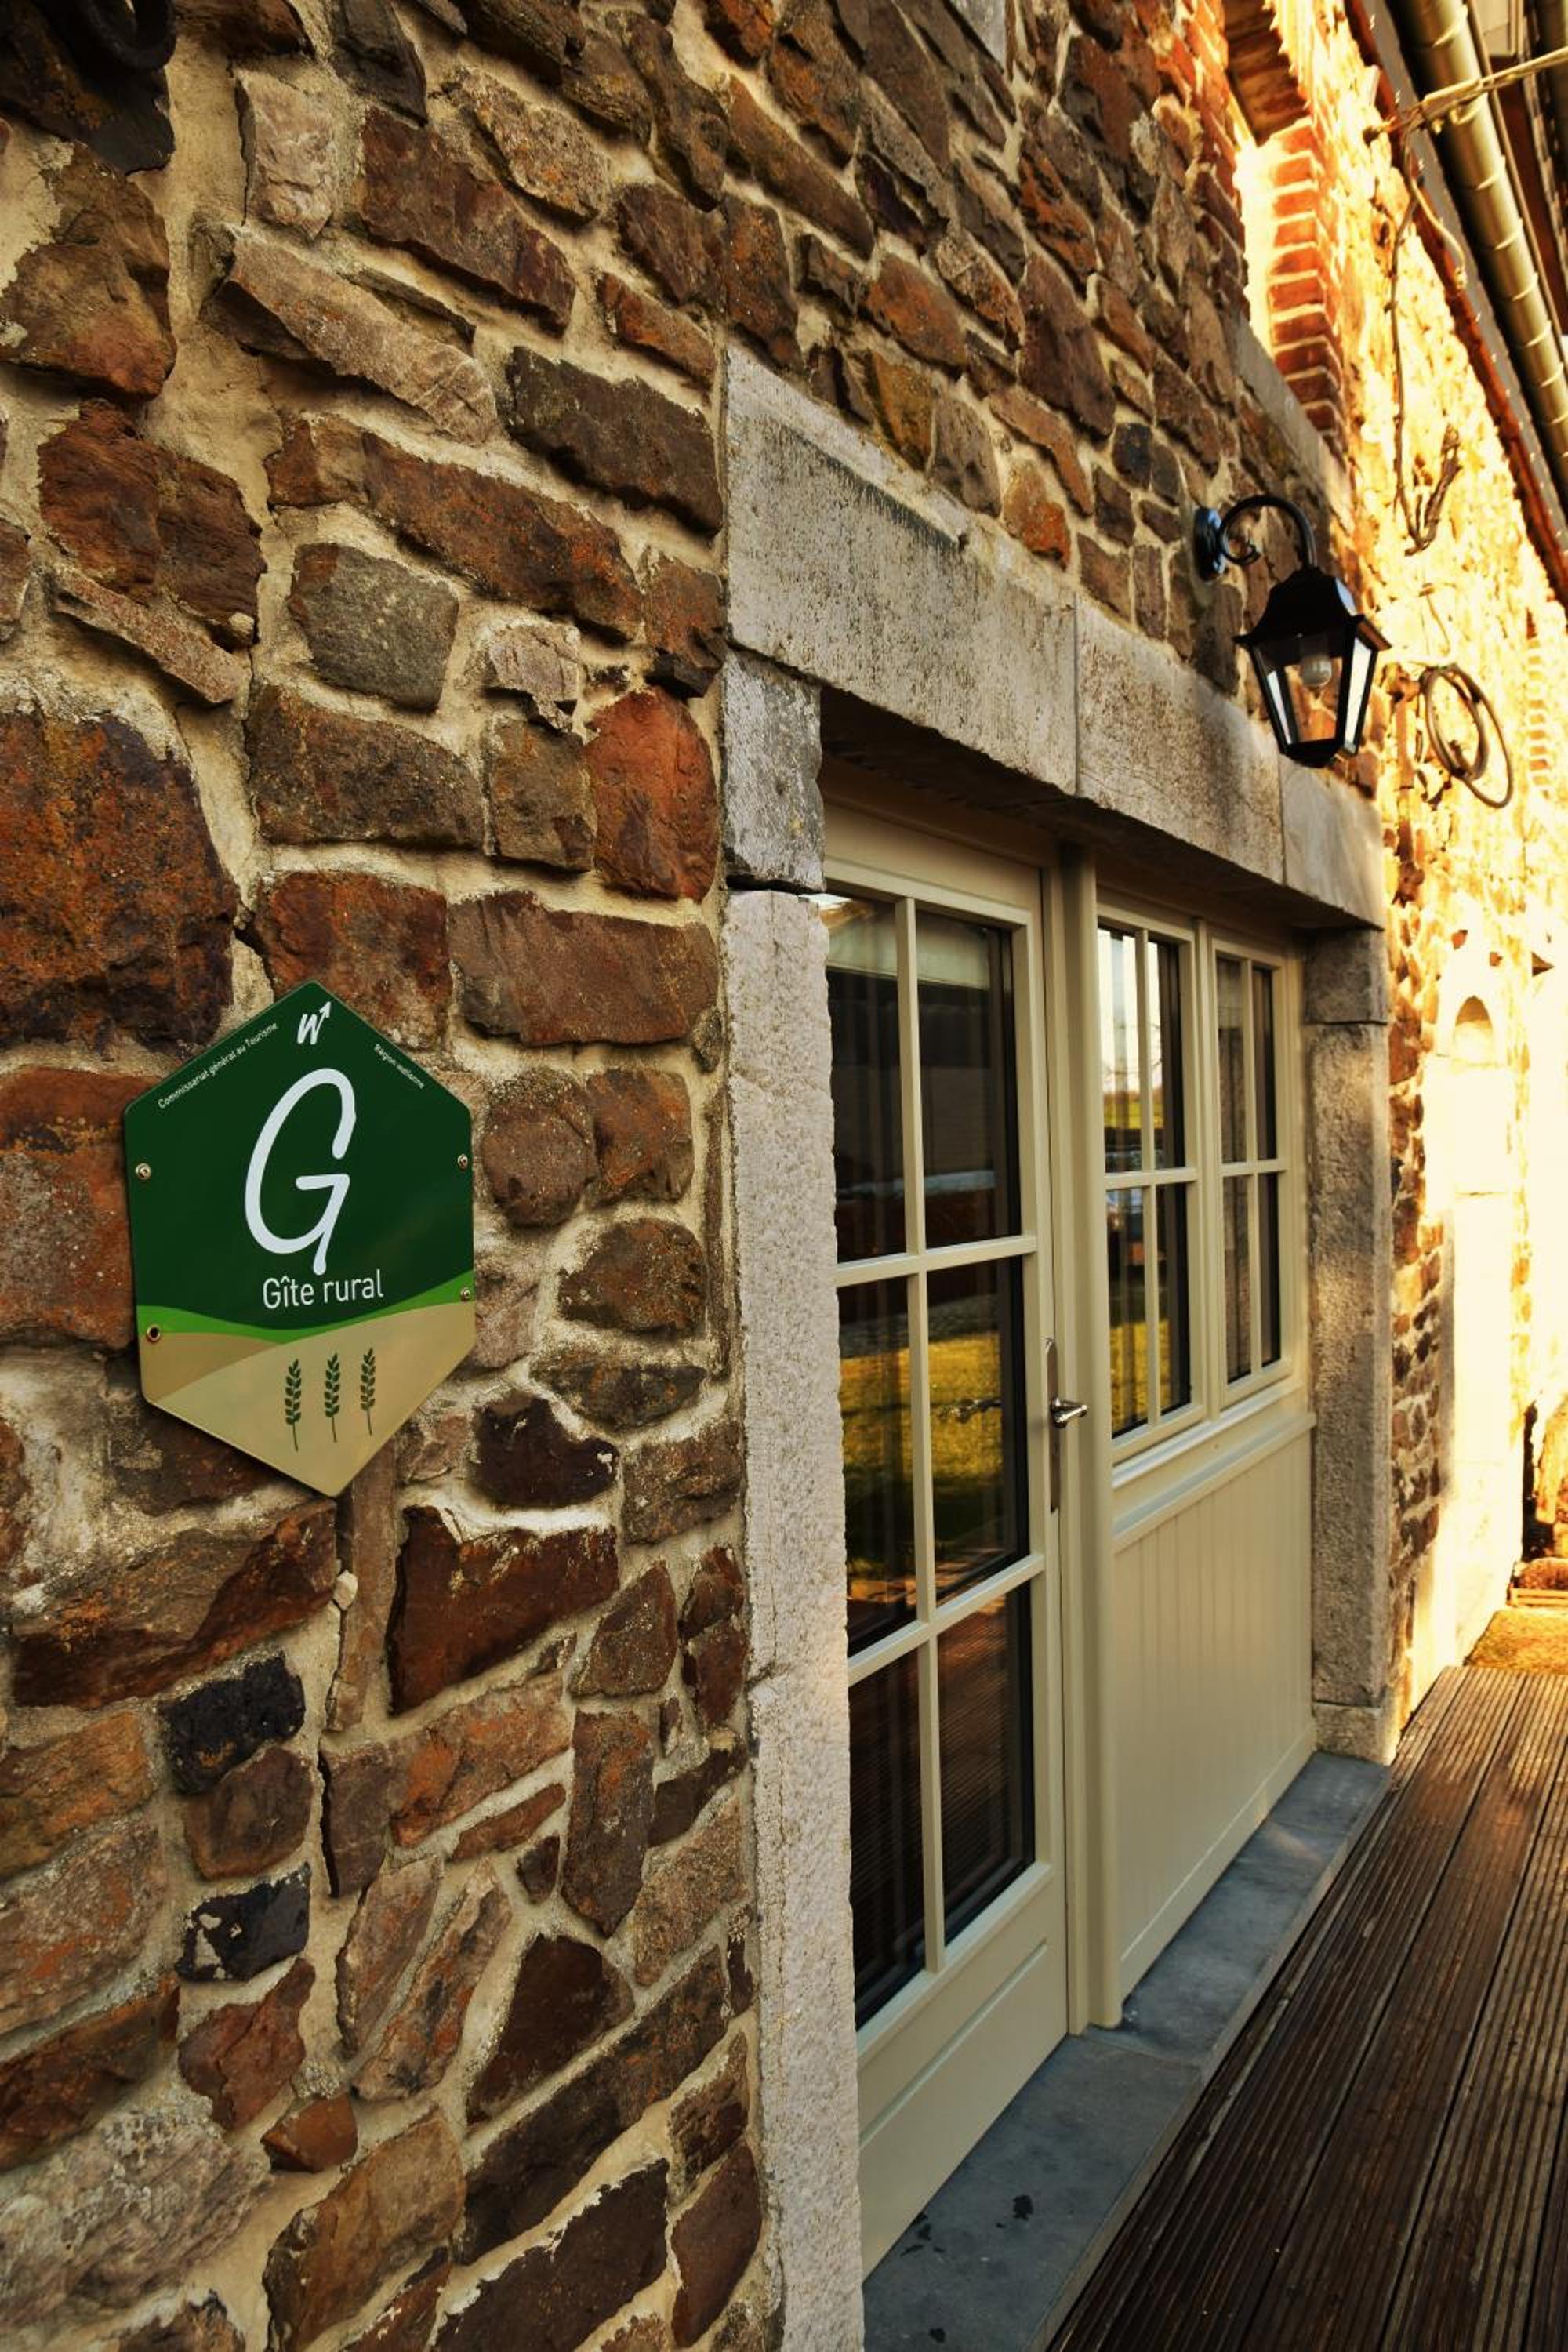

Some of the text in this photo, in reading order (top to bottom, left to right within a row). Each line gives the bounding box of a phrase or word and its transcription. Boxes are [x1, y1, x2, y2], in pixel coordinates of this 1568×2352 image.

[158, 1069, 210, 1109] Commissariat
[236, 1044, 246, 1055] au
[245, 1068, 356, 1276] G
[263, 1268, 384, 1309] Gîte rural
